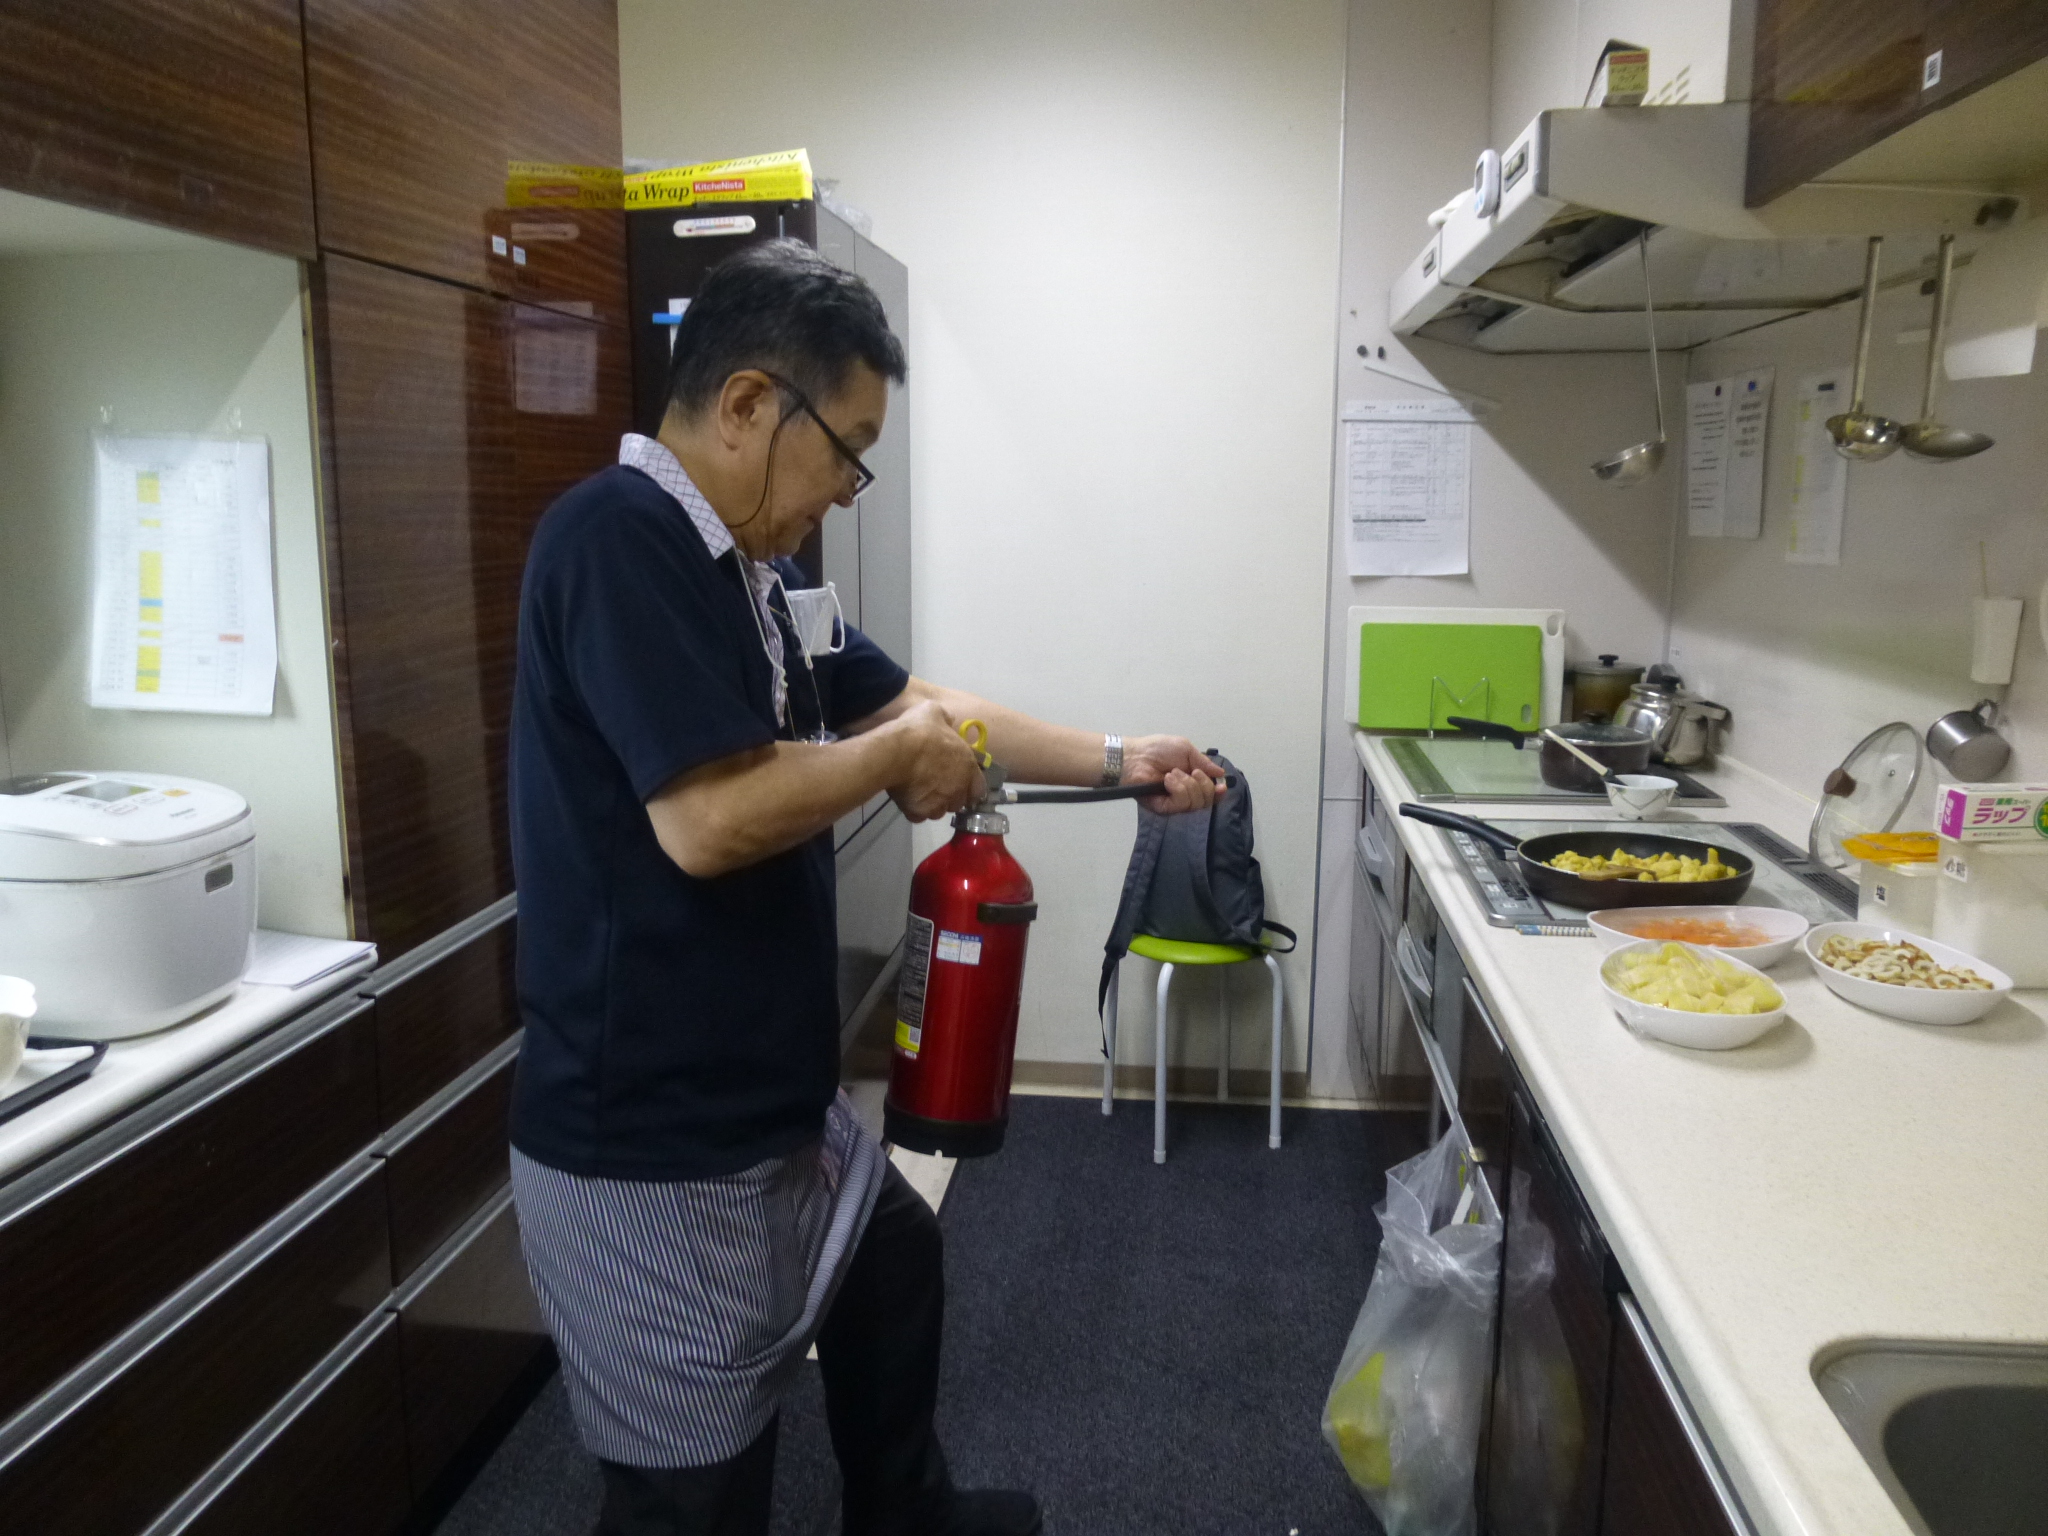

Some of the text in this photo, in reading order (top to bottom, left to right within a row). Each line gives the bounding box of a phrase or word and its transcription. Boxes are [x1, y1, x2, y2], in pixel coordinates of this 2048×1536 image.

[643, 183, 690, 203] Wrap
[694, 181, 744, 193] KitcheNista
[1972, 805, 2032, 825] ラップ
